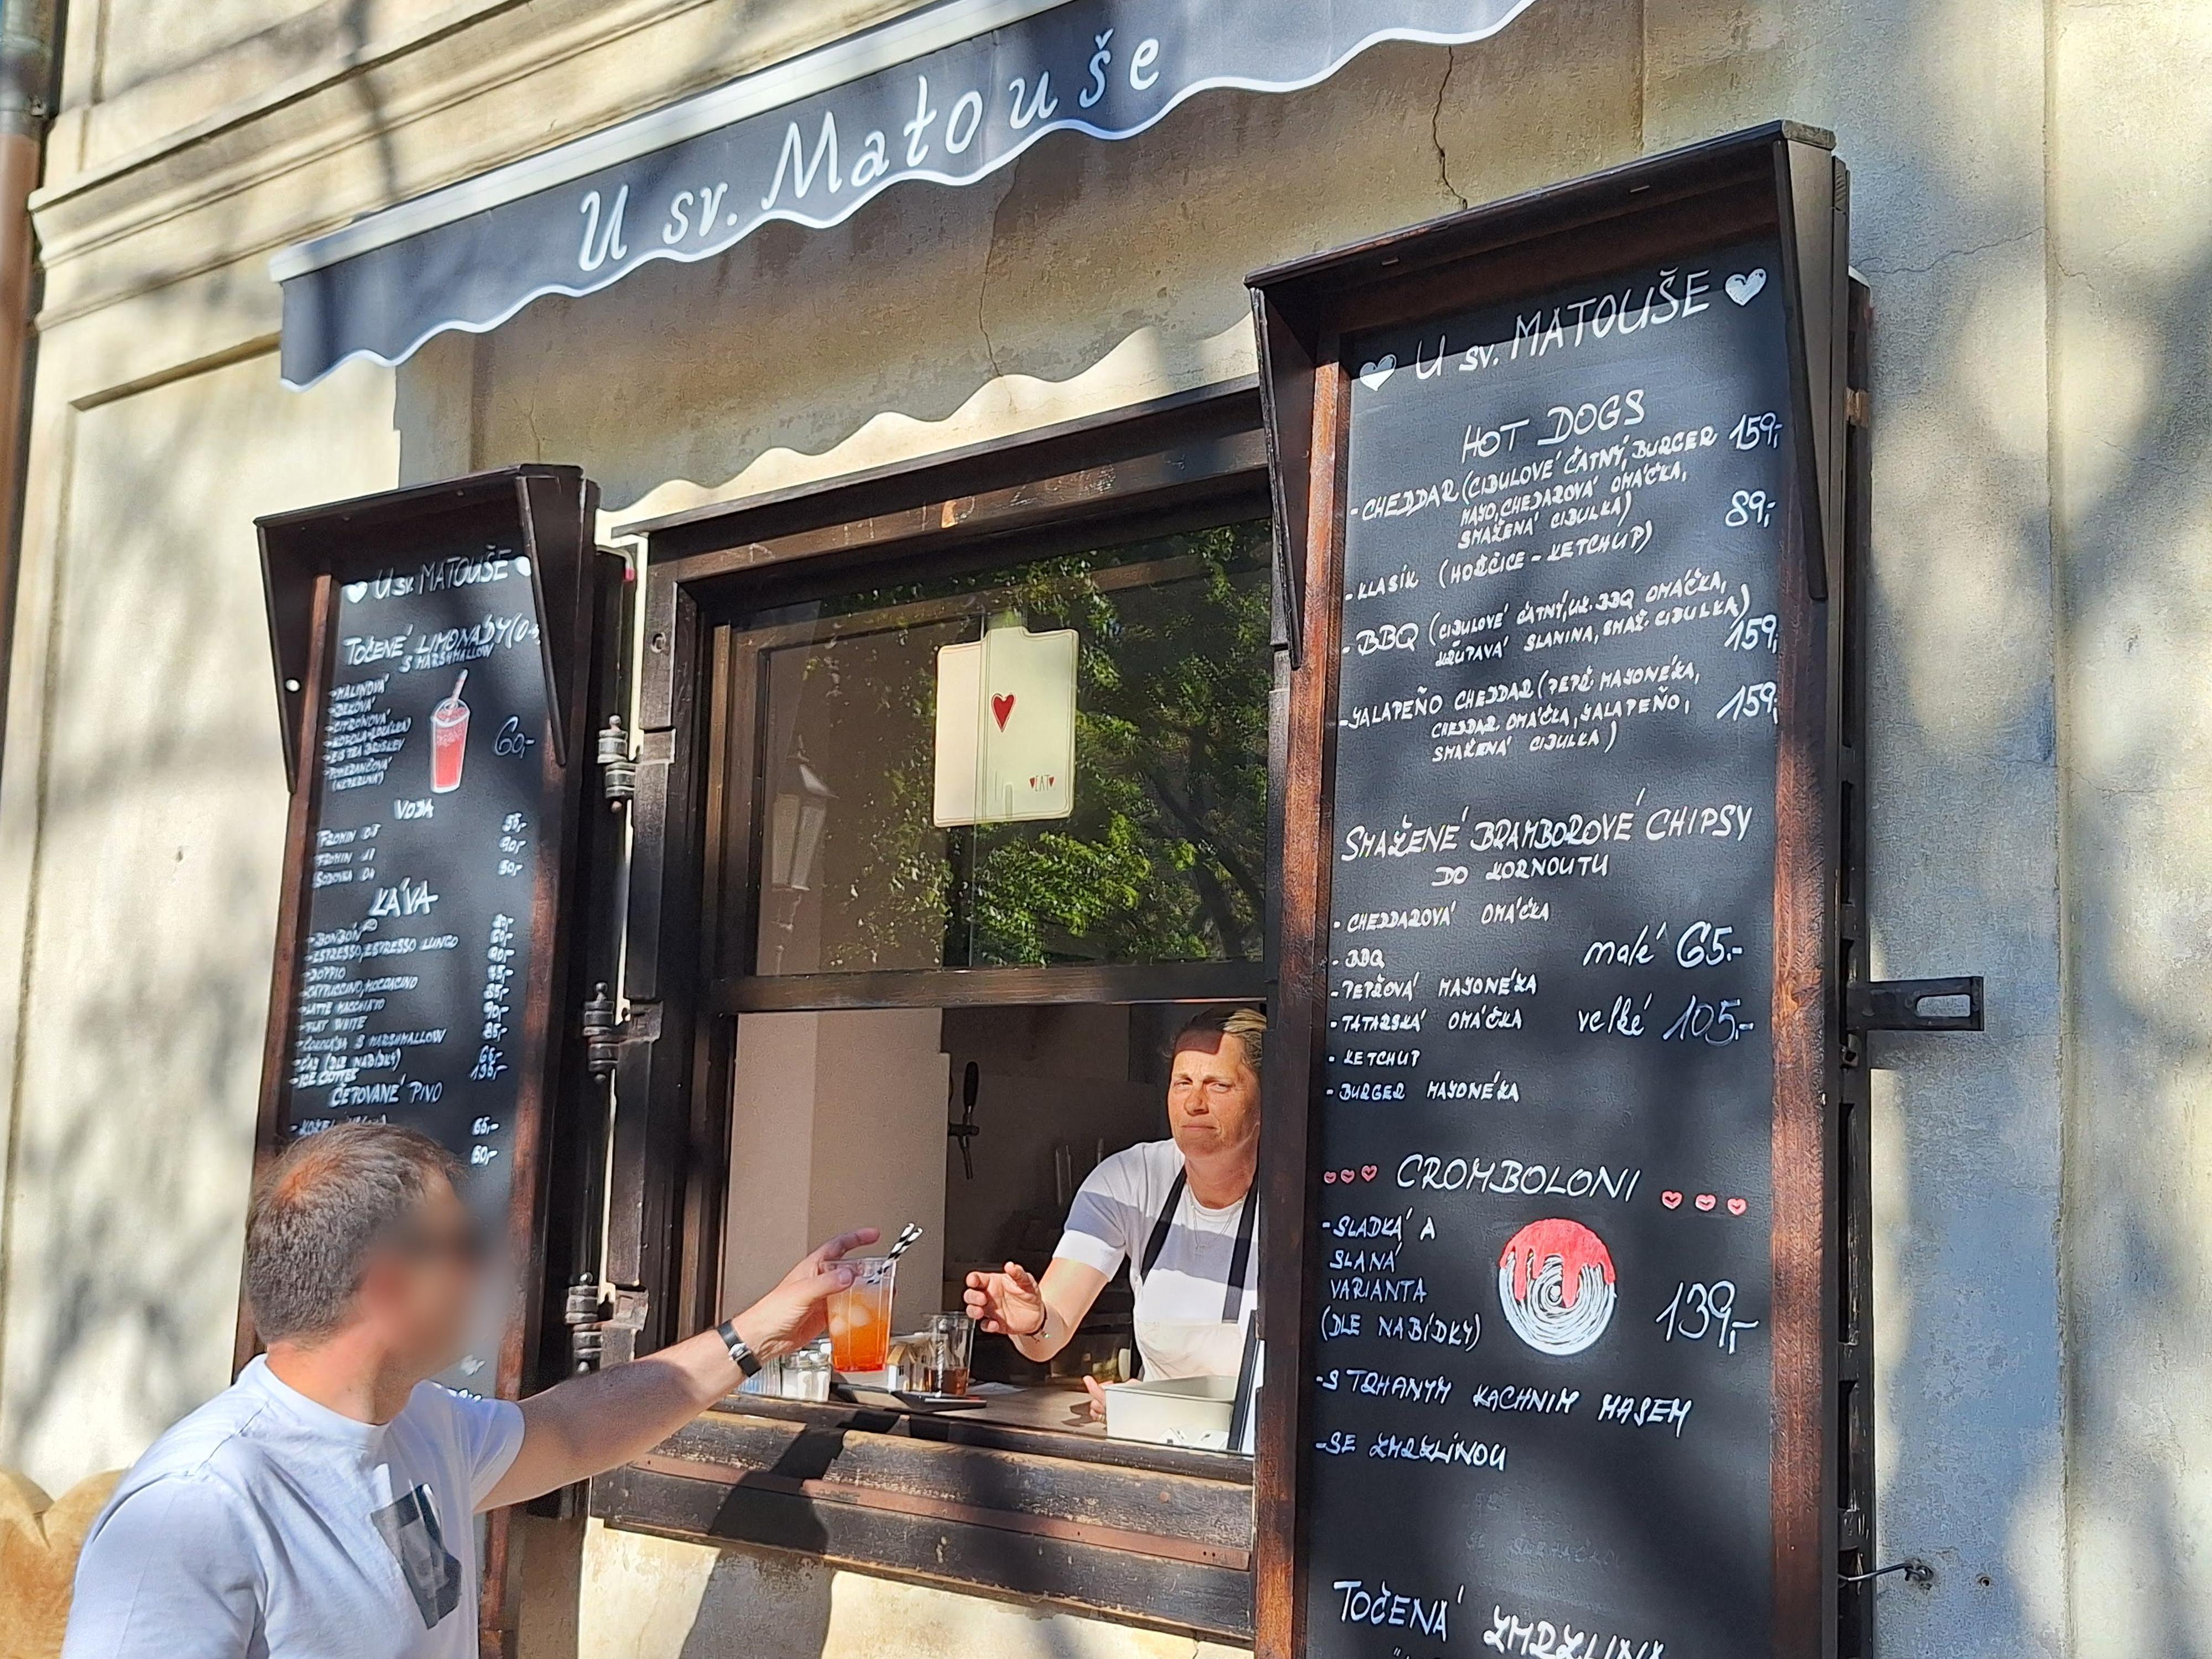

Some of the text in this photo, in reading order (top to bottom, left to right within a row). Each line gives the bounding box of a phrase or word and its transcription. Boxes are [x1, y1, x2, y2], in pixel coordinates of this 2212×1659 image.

[578, 28, 1160, 273] U sv. Matouše
[1415, 266, 1710, 380] U sv. MATOUŠE
[1461, 389, 1646, 464] HOT DOGS
[1631, 425, 1718, 460] BURGER
[1610, 460, 1687, 494] OMÁČKA,
[1457, 490, 1632, 550] SMAŽENÁ CIBULKA)
[1546, 519, 1653, 562] KETCHUP)
[373, 567, 394, 600] U
[418, 543, 512, 595] MATOUŠE
[1428, 603, 1510, 647] (CIBULOVÉ
[1595, 587, 1635, 611] BBQ
[1645, 567, 1728, 604] OMÁČKA,
[1524, 623, 1600, 653] SLANINA,
[1654, 583, 1751, 630] CIBULKA)
[398, 642, 496, 674] S MARSHMALLOW
[1454, 678, 1535, 712] CHEDDAR
[494, 716, 536, 759] 60,-
[1432, 735, 1512, 763] SMAŽENÁ
[393, 797, 434, 821] VODA
[1340, 788, 1753, 862] SMAŽENÉ BRAMBOROVÉ CHIPSY
[1431, 853, 1610, 886] DO KORNOUTU
[367, 875, 439, 919] KÁVA
[1480, 896, 1550, 925] OMÁČKA
[1582, 921, 1667, 967] malé
[330, 1015, 369, 1032] WHITE
[1447, 1004, 1522, 1030] OMÁČKA
[1578, 992, 1653, 1036] velké
[354, 1034, 367, 1050] S
[368, 1027, 447, 1048] MARSHMALLOW
[328, 1073, 444, 1108] ČEPOVANÉ PIVO
[1397, 1153, 1641, 1203] CROMBOLONI
[1420, 1215, 1436, 1240] A
[1329, 1241, 1403, 1274] SLANÁ
[1329, 1276, 1428, 1304] VARIANTA
[1321, 1305, 1482, 1353] (DLE NABÍDKY)
[1655, 1280, 1760, 1355] 139,-
[1472, 1383, 1580, 1414] KACHNIM
[1597, 1393, 1693, 1438] MASEM
[1333, 1580, 1465, 1643] TOČENÁ
